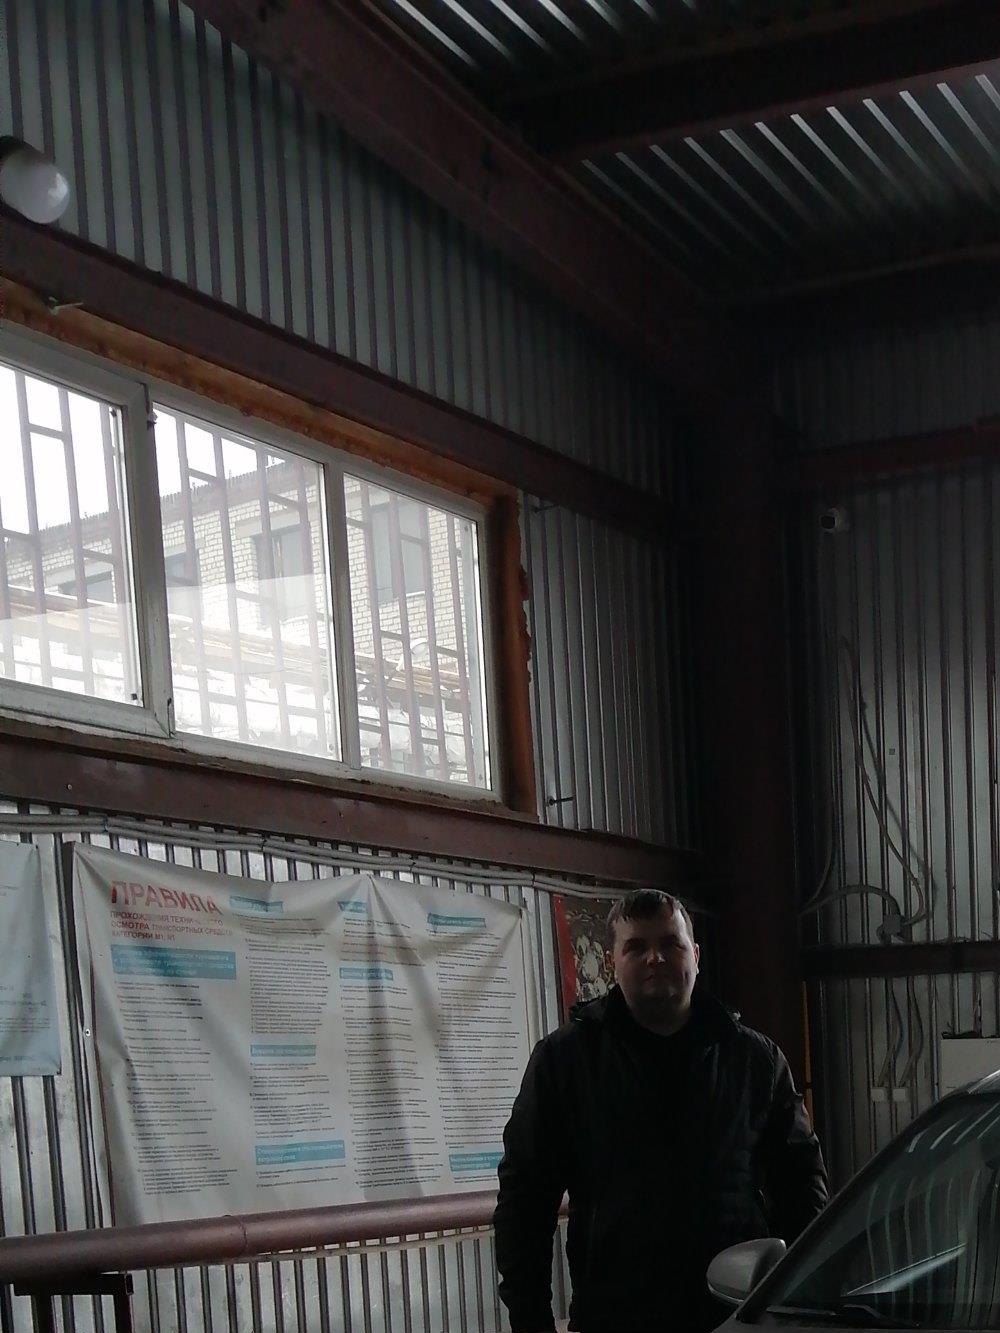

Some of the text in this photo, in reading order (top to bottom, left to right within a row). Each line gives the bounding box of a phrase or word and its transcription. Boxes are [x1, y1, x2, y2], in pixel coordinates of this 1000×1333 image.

[111, 881, 224, 915] ПРАВИЛА
[110, 911, 169, 923] ПРОХОЖИЯ
[111, 921, 150, 930] ОСМОТРА
